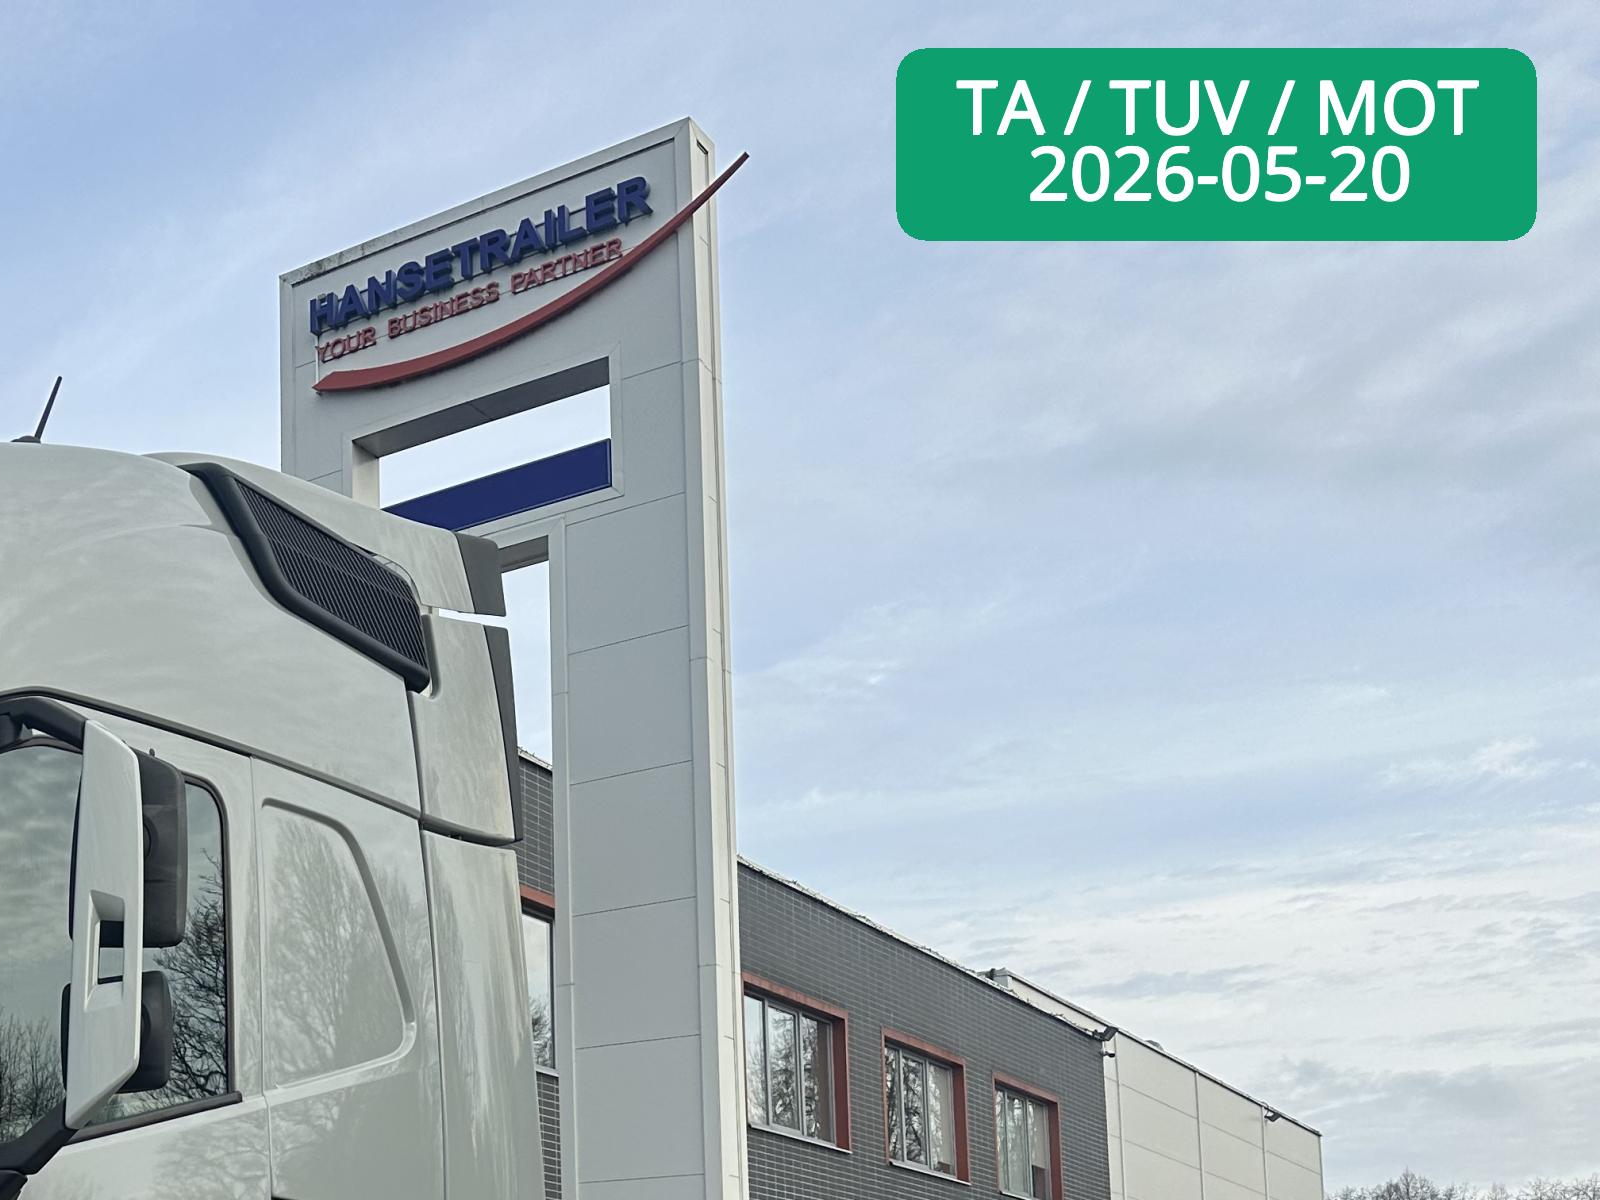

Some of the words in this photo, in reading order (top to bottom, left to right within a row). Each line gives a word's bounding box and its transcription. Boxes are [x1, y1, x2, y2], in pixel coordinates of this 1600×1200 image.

[309, 176, 654, 335] HANSETRAILER
[317, 326, 376, 363] YOUR
[387, 281, 500, 338] BUSINESS
[510, 238, 624, 295] PARTNER
